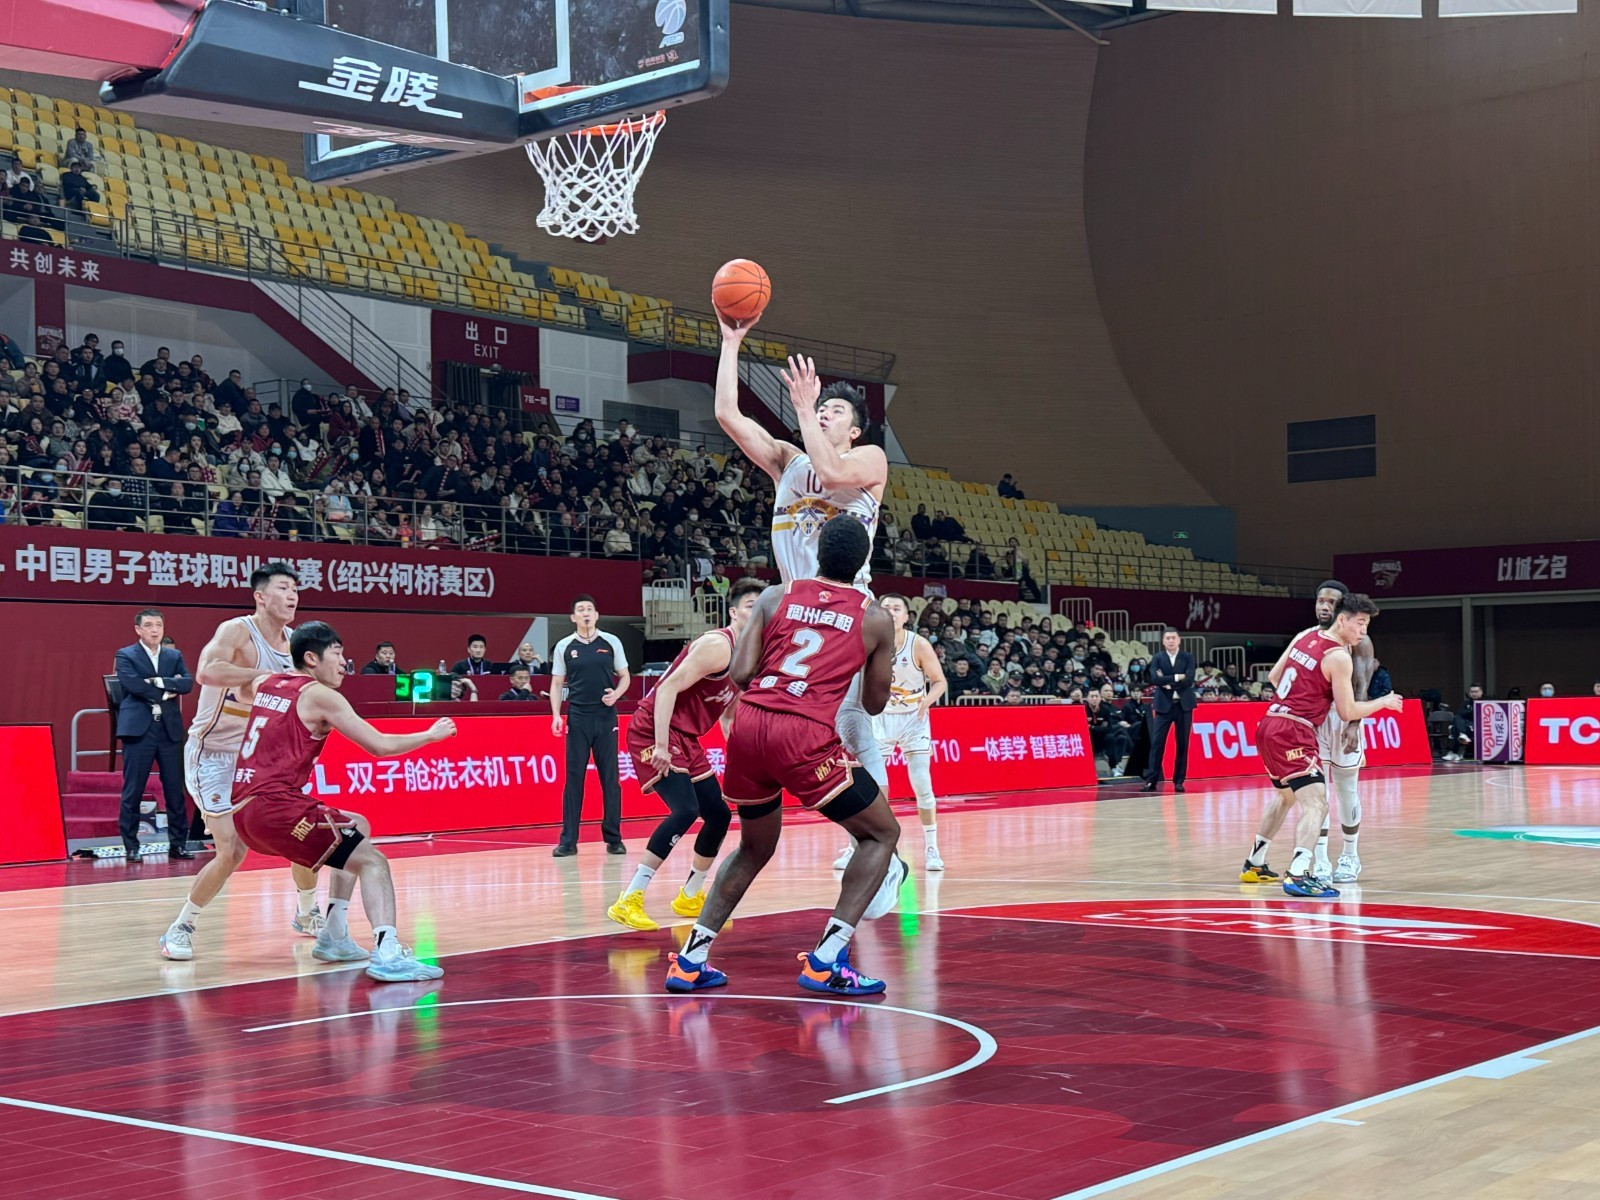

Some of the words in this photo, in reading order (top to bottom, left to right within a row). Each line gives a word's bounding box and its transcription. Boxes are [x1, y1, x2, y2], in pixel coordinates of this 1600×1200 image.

[298, 56, 463, 119] 金陵
[10, 247, 100, 281] 共创未来
[465, 320, 508, 345] 出口
[474, 343, 499, 359] EXIT
[15, 543, 495, 598] 中国男子篮球职业赛(绍兴柯桥赛区)
[1497, 555, 1567, 582] 以城之名
[779, 627, 825, 679] 2
[412, 672, 432, 703] 2
[1276, 667, 1297, 700] 6
[241, 715, 269, 760] 5
[970, 735, 1028, 762] 一体美学
[1029, 733, 1085, 760] 智慧柔烘
[1192, 720, 1258, 759] TCL
[345, 754, 557, 795] 双子舱洗衣机T10
